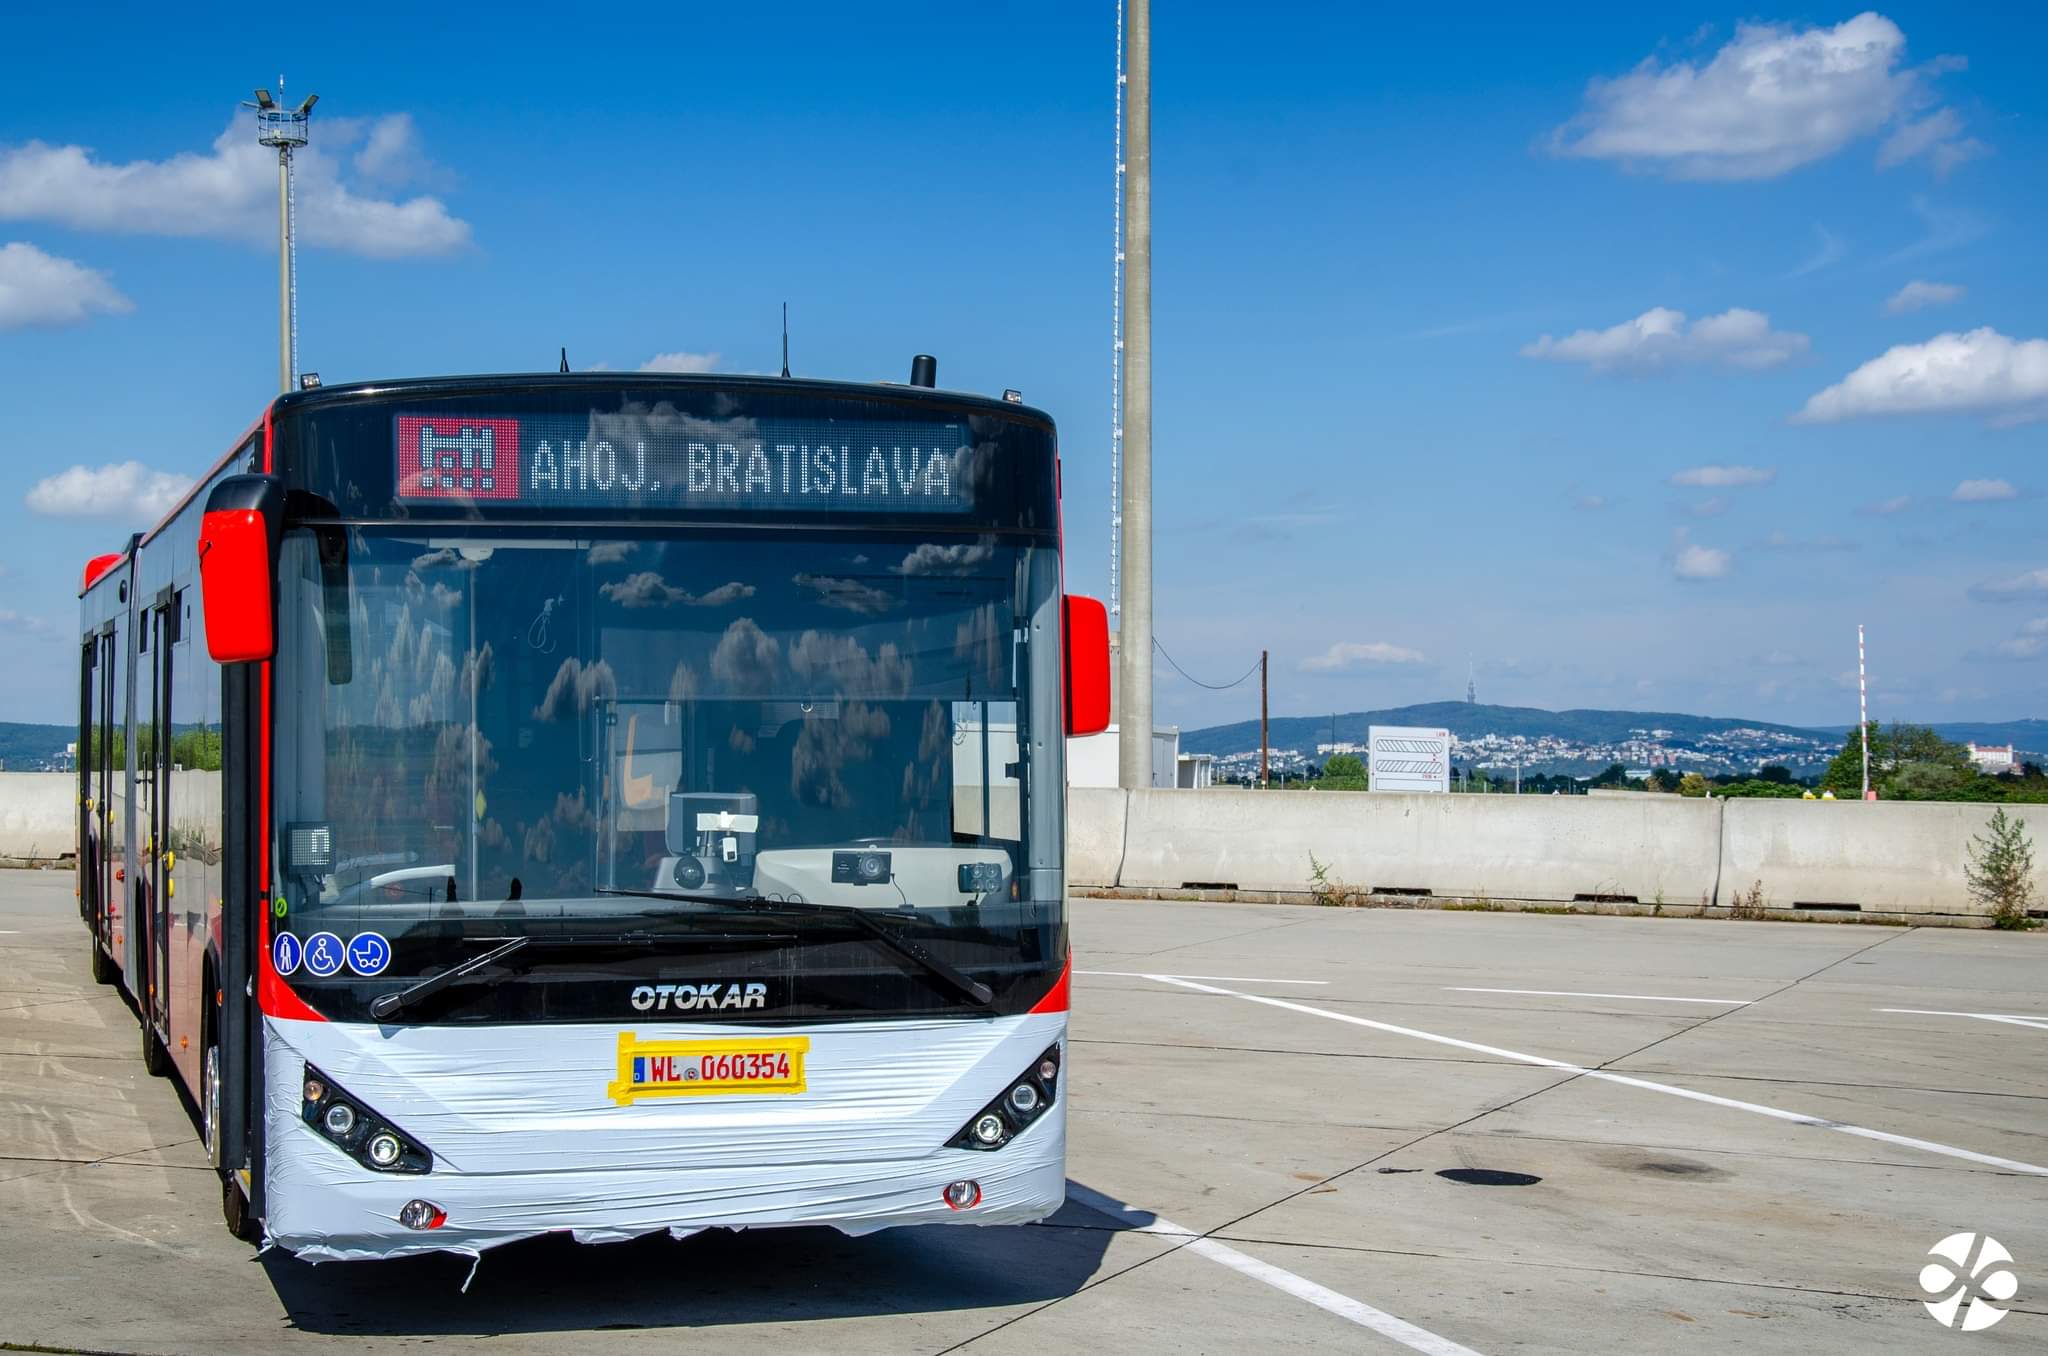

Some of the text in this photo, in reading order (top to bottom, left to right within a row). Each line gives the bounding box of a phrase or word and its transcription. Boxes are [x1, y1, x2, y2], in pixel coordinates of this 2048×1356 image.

[531, 440, 949, 495] AHOJ, BRATISLAVA
[631, 983, 767, 1011] OTOKAR
[651, 1053, 790, 1082] WL 060354
